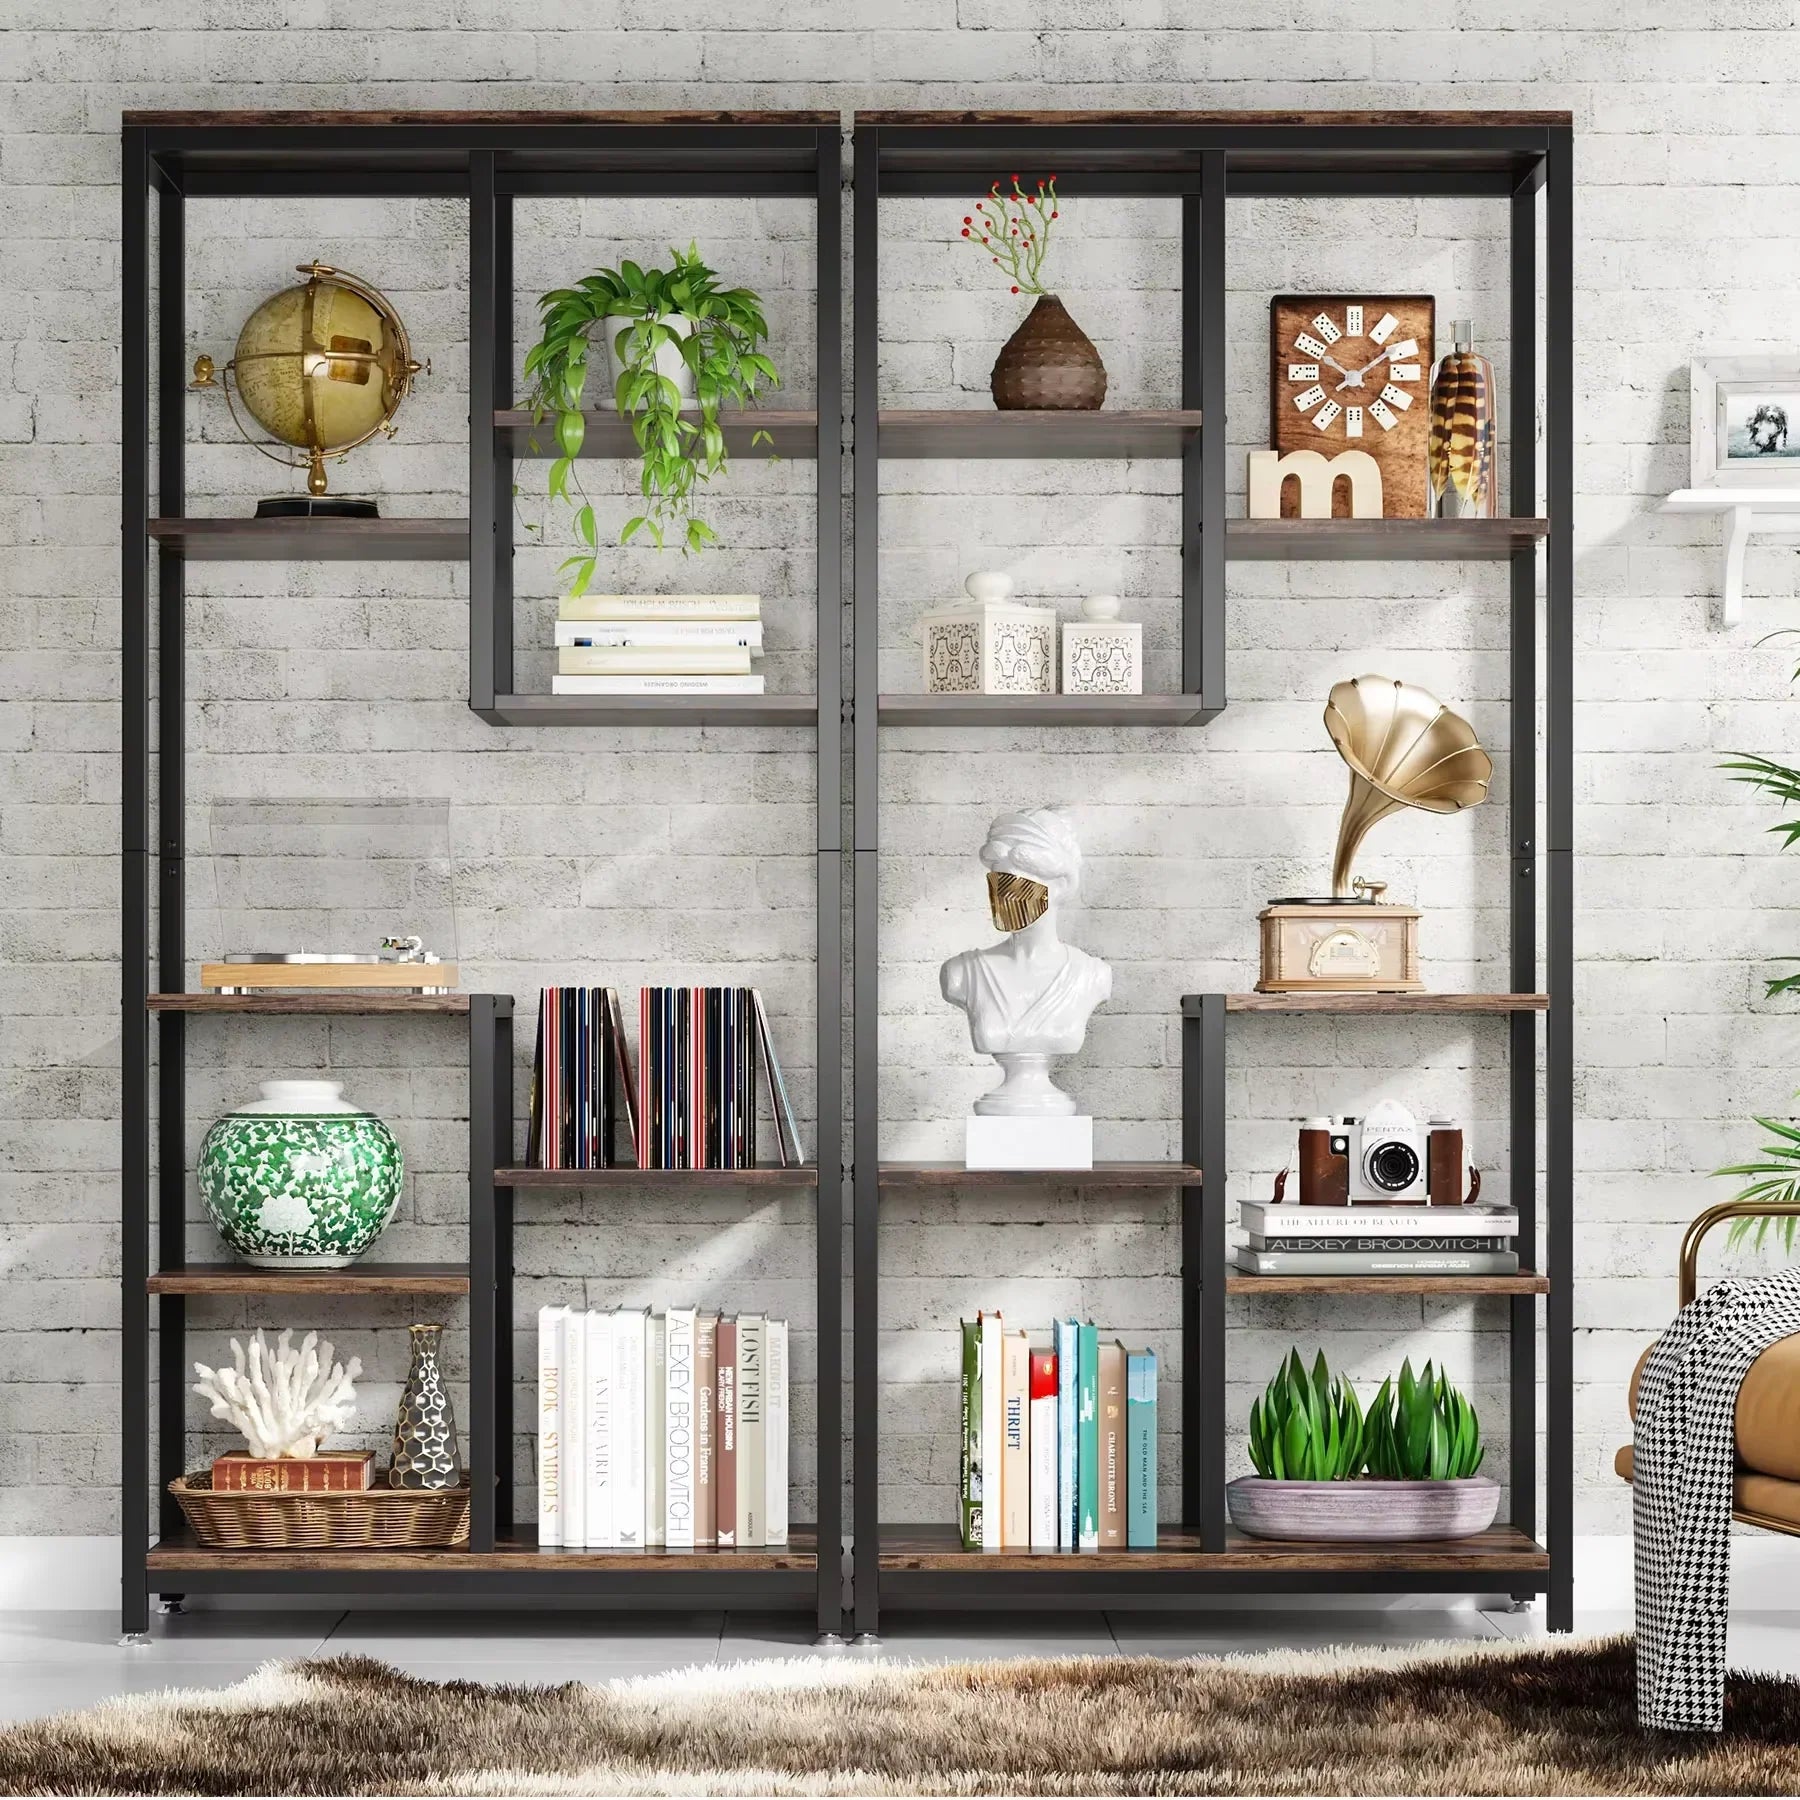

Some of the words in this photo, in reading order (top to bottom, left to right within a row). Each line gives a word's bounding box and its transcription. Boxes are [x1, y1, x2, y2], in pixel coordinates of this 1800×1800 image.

[1249, 449, 1383, 519] m
[1271, 1238, 1350, 1250] ALEXEY
[1358, 1238, 1490, 1250] BRODOVITCH
[669, 1318, 690, 1395] ALEXEY
[741, 1327, 760, 1376] LOST
[768, 1337, 781, 1393] MAKING
[543, 1367, 559, 1412] BOOK
[725, 1366, 733, 1385] NEW
[699, 1386, 711, 1431] Gardens
[725, 1386, 733, 1413] URBAN
[741, 1381, 760, 1424] FISH
[768, 1394, 781, 1409] IT
[699, 1433, 711, 1444] in
[725, 1414, 733, 1451] HOUSING
[1007, 1396, 1021, 1451] THRIFT
[543, 1431, 559, 1514] SYMBOLS
[669, 1402, 690, 1531] BRODOVITCH
[699, 1448, 711, 1485] France
[1107, 1431, 1116, 1479] CHARLOTTE
